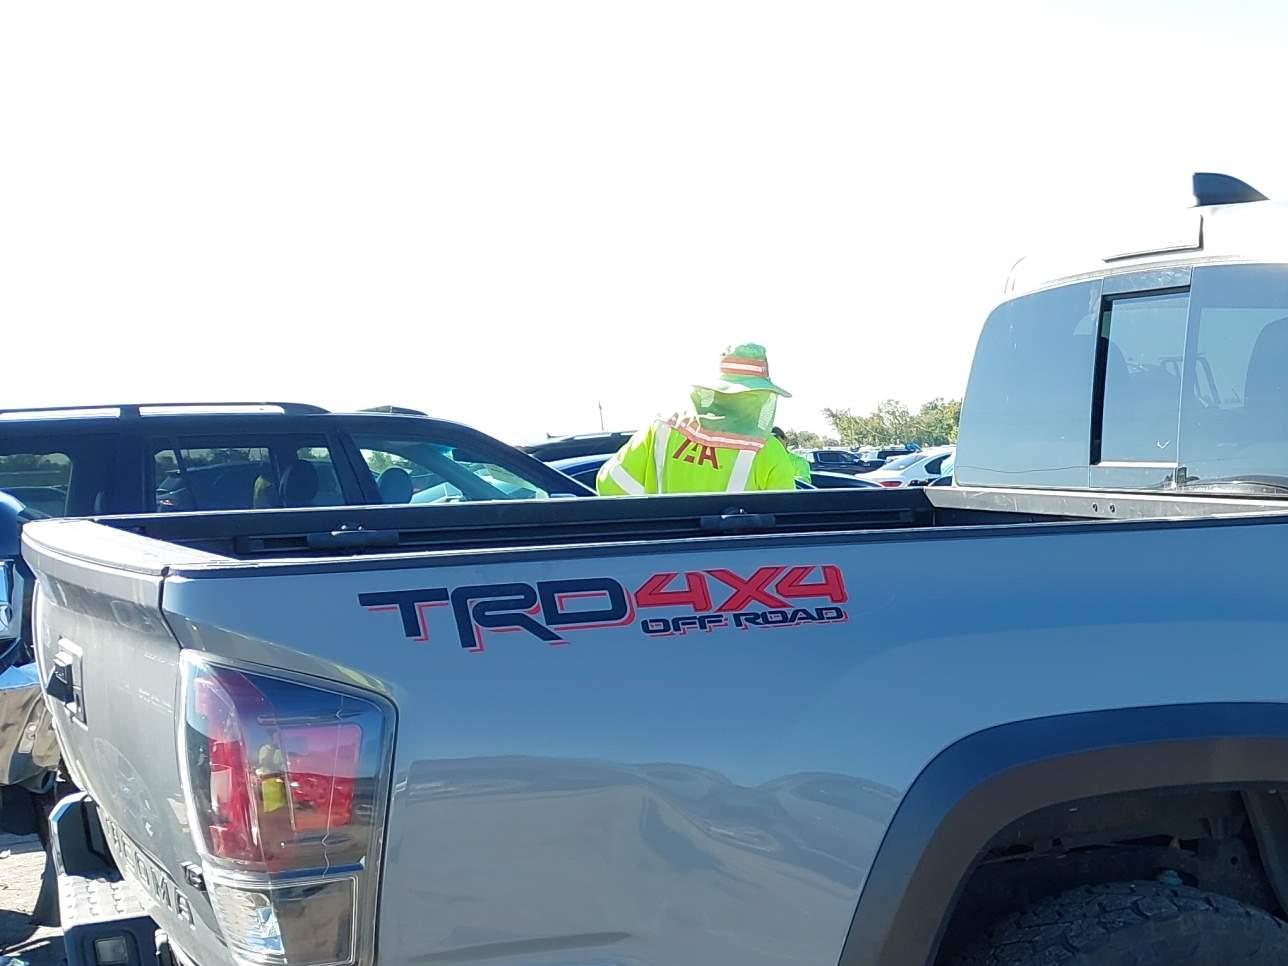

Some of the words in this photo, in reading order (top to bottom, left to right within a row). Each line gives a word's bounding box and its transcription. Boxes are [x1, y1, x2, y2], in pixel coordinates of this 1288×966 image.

[358, 577, 635, 653] TRD
[641, 615, 727, 638] OFF
[734, 606, 849, 630] ROAD
